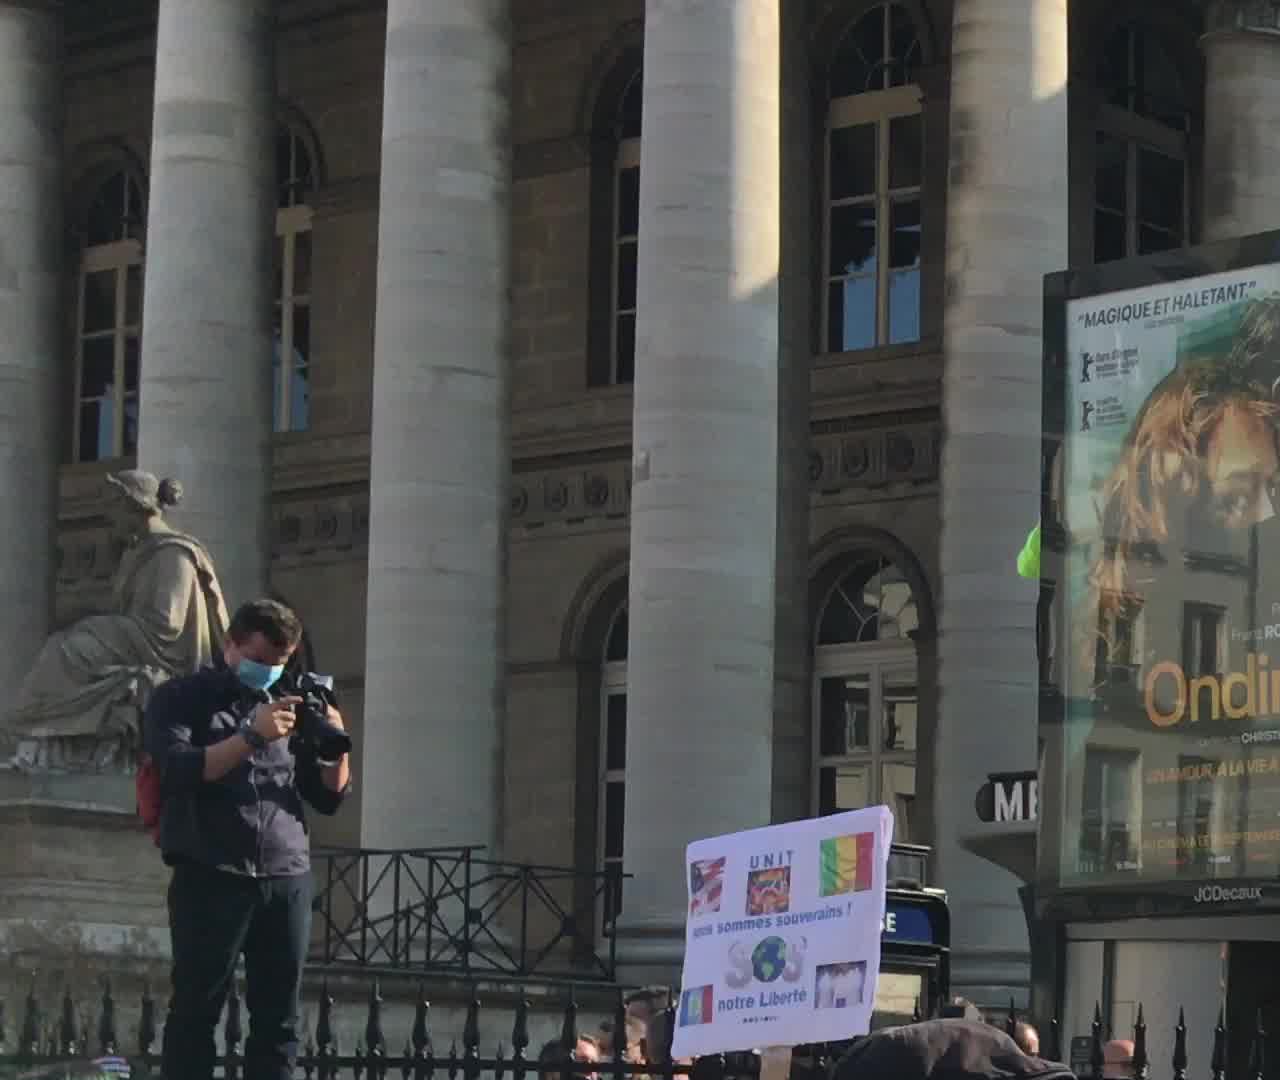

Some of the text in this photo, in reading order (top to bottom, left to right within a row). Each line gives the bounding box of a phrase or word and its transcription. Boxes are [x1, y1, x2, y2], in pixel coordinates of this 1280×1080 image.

[1153, 298, 1171, 315] ET
[1194, 885, 1262, 903] JCDecaux
[716, 915, 772, 934] sommes
[776, 903, 843, 927] souverains
[717, 987, 807, 1011] notre Liberté
